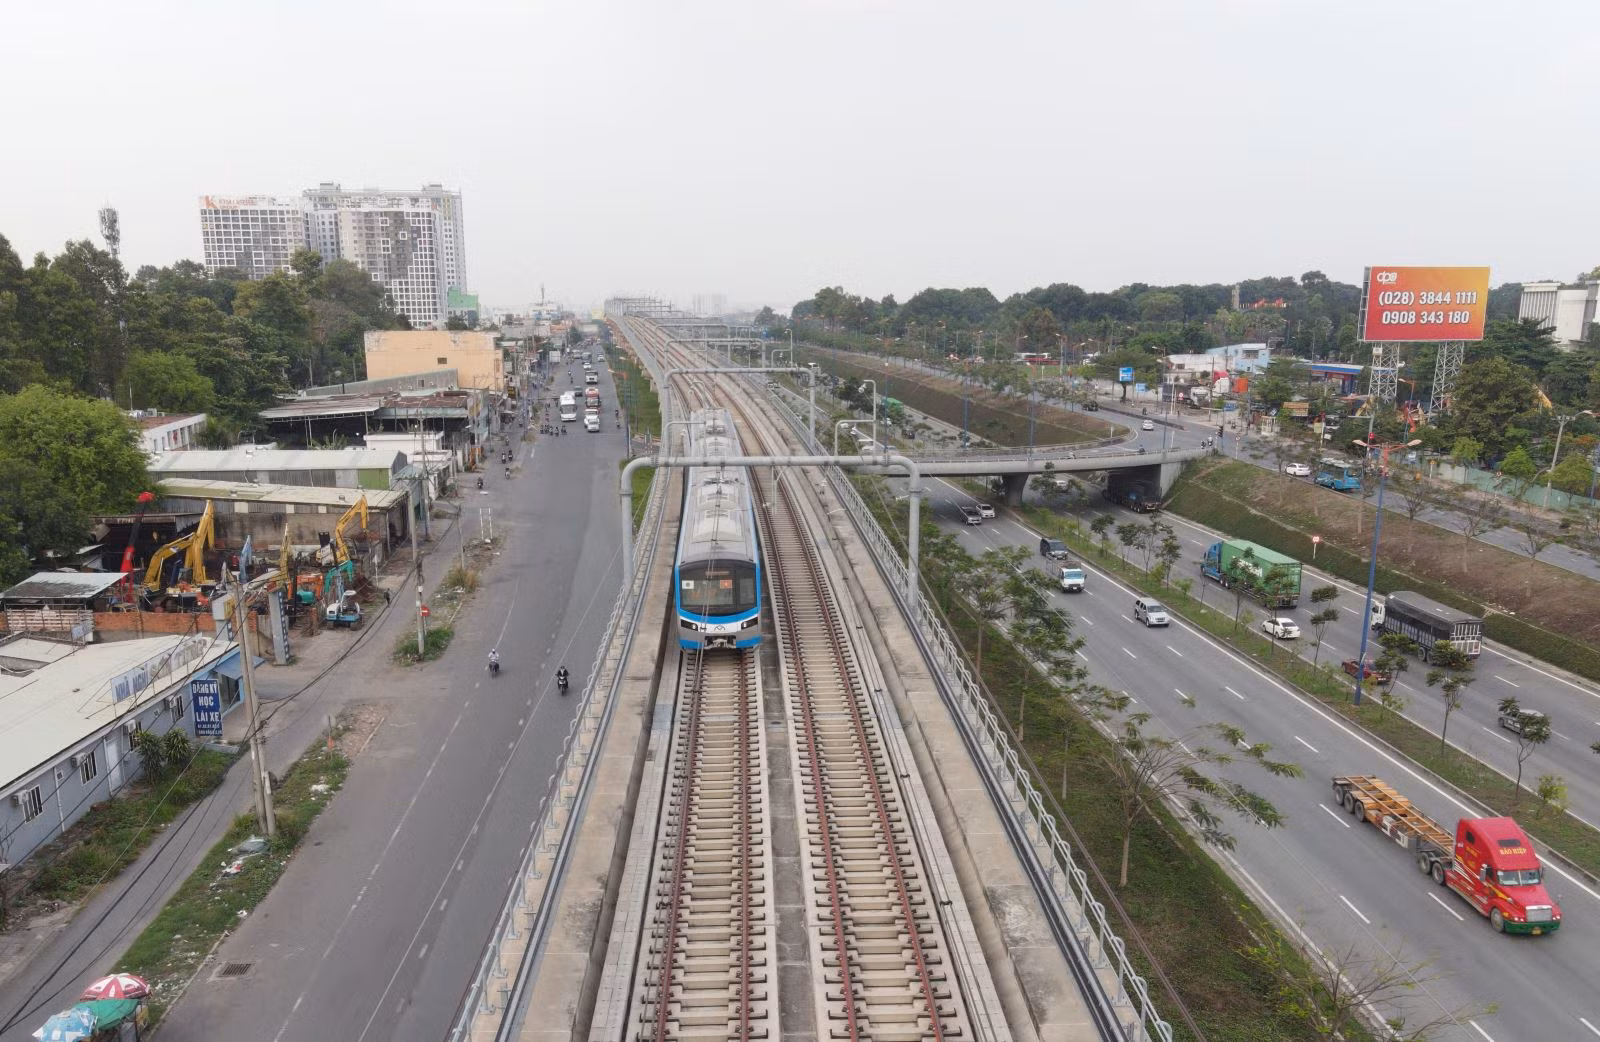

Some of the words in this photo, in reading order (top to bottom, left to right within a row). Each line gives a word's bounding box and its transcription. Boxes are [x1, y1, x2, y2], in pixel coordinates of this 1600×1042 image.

[1378, 291, 1415, 306] (028)
[1419, 291, 1451, 305] 3844
[1455, 291, 1477, 304] 1111
[1382, 311, 1416, 324] 0908
[1420, 311, 1444, 324] 343
[1448, 311, 1470, 324] 180
[198, 696, 214, 708] HỌC
[209, 711, 220, 722] XE
